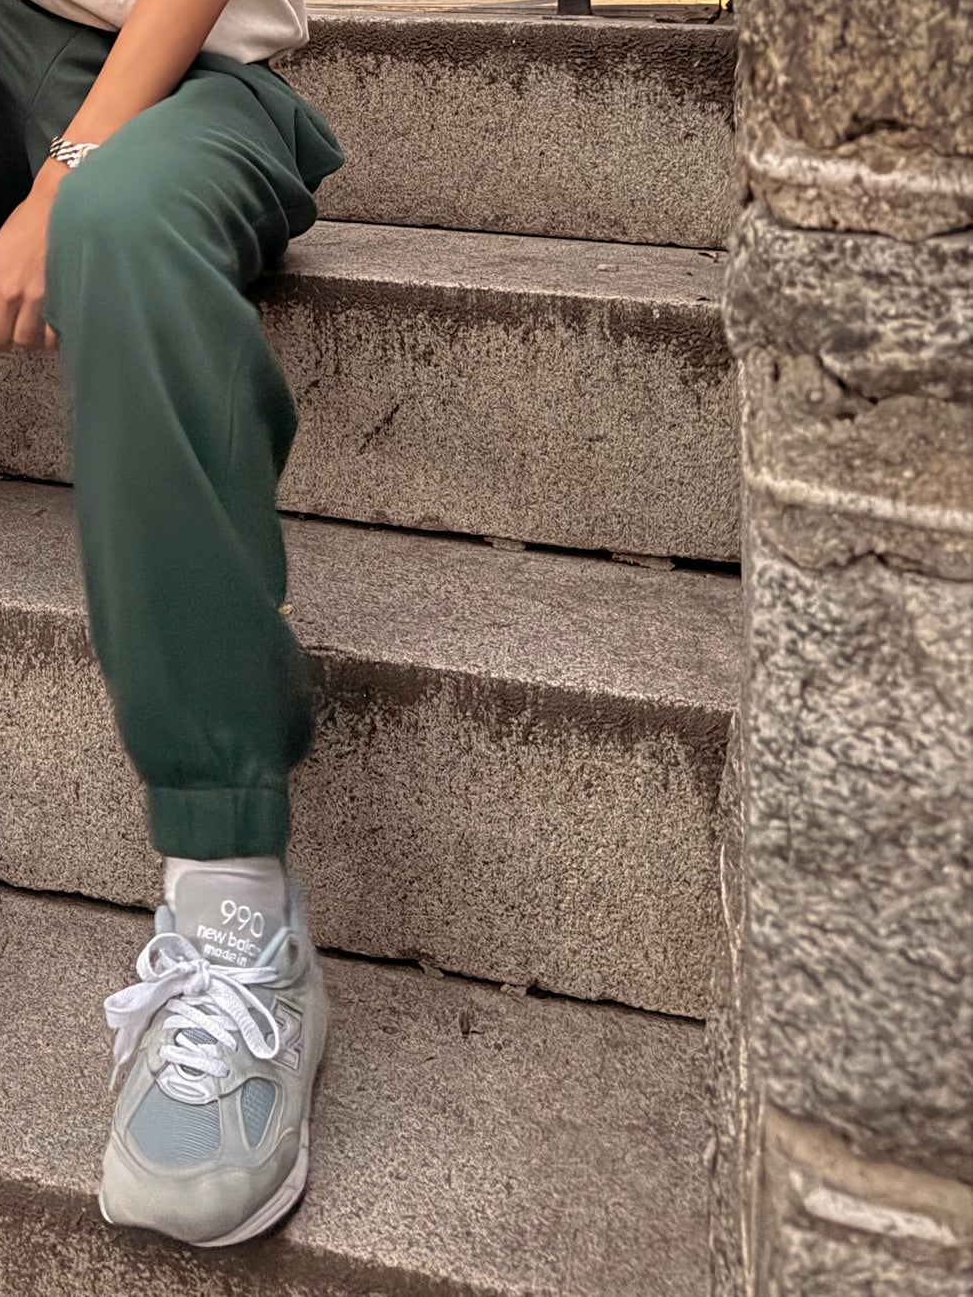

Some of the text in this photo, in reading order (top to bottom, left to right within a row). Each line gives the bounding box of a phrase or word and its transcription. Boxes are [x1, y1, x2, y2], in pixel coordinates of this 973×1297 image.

[220, 899, 265, 938] 990
[196, 924, 228, 945] new
[203, 943, 237, 964] made
